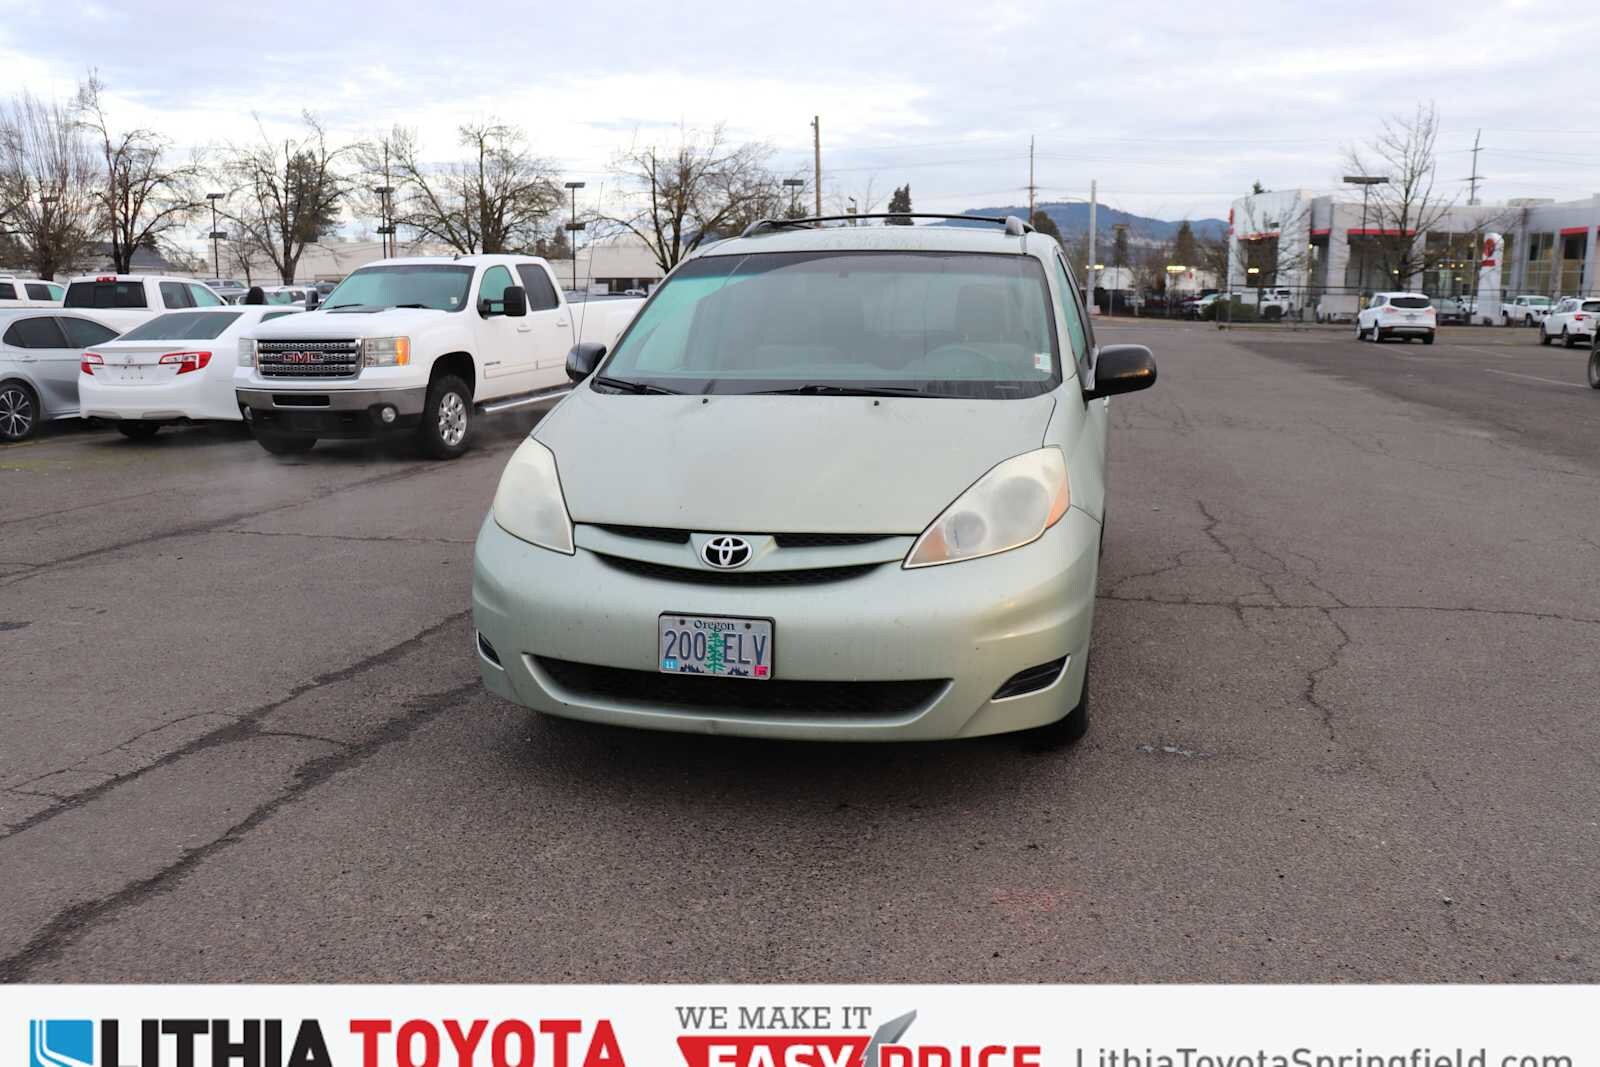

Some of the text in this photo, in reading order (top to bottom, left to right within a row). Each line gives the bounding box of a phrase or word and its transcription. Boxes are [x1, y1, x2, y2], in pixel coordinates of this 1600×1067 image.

[281, 352, 323, 363] GMC
[694, 620, 735, 631] Oregon
[664, 630, 766, 665] 200 ELV
